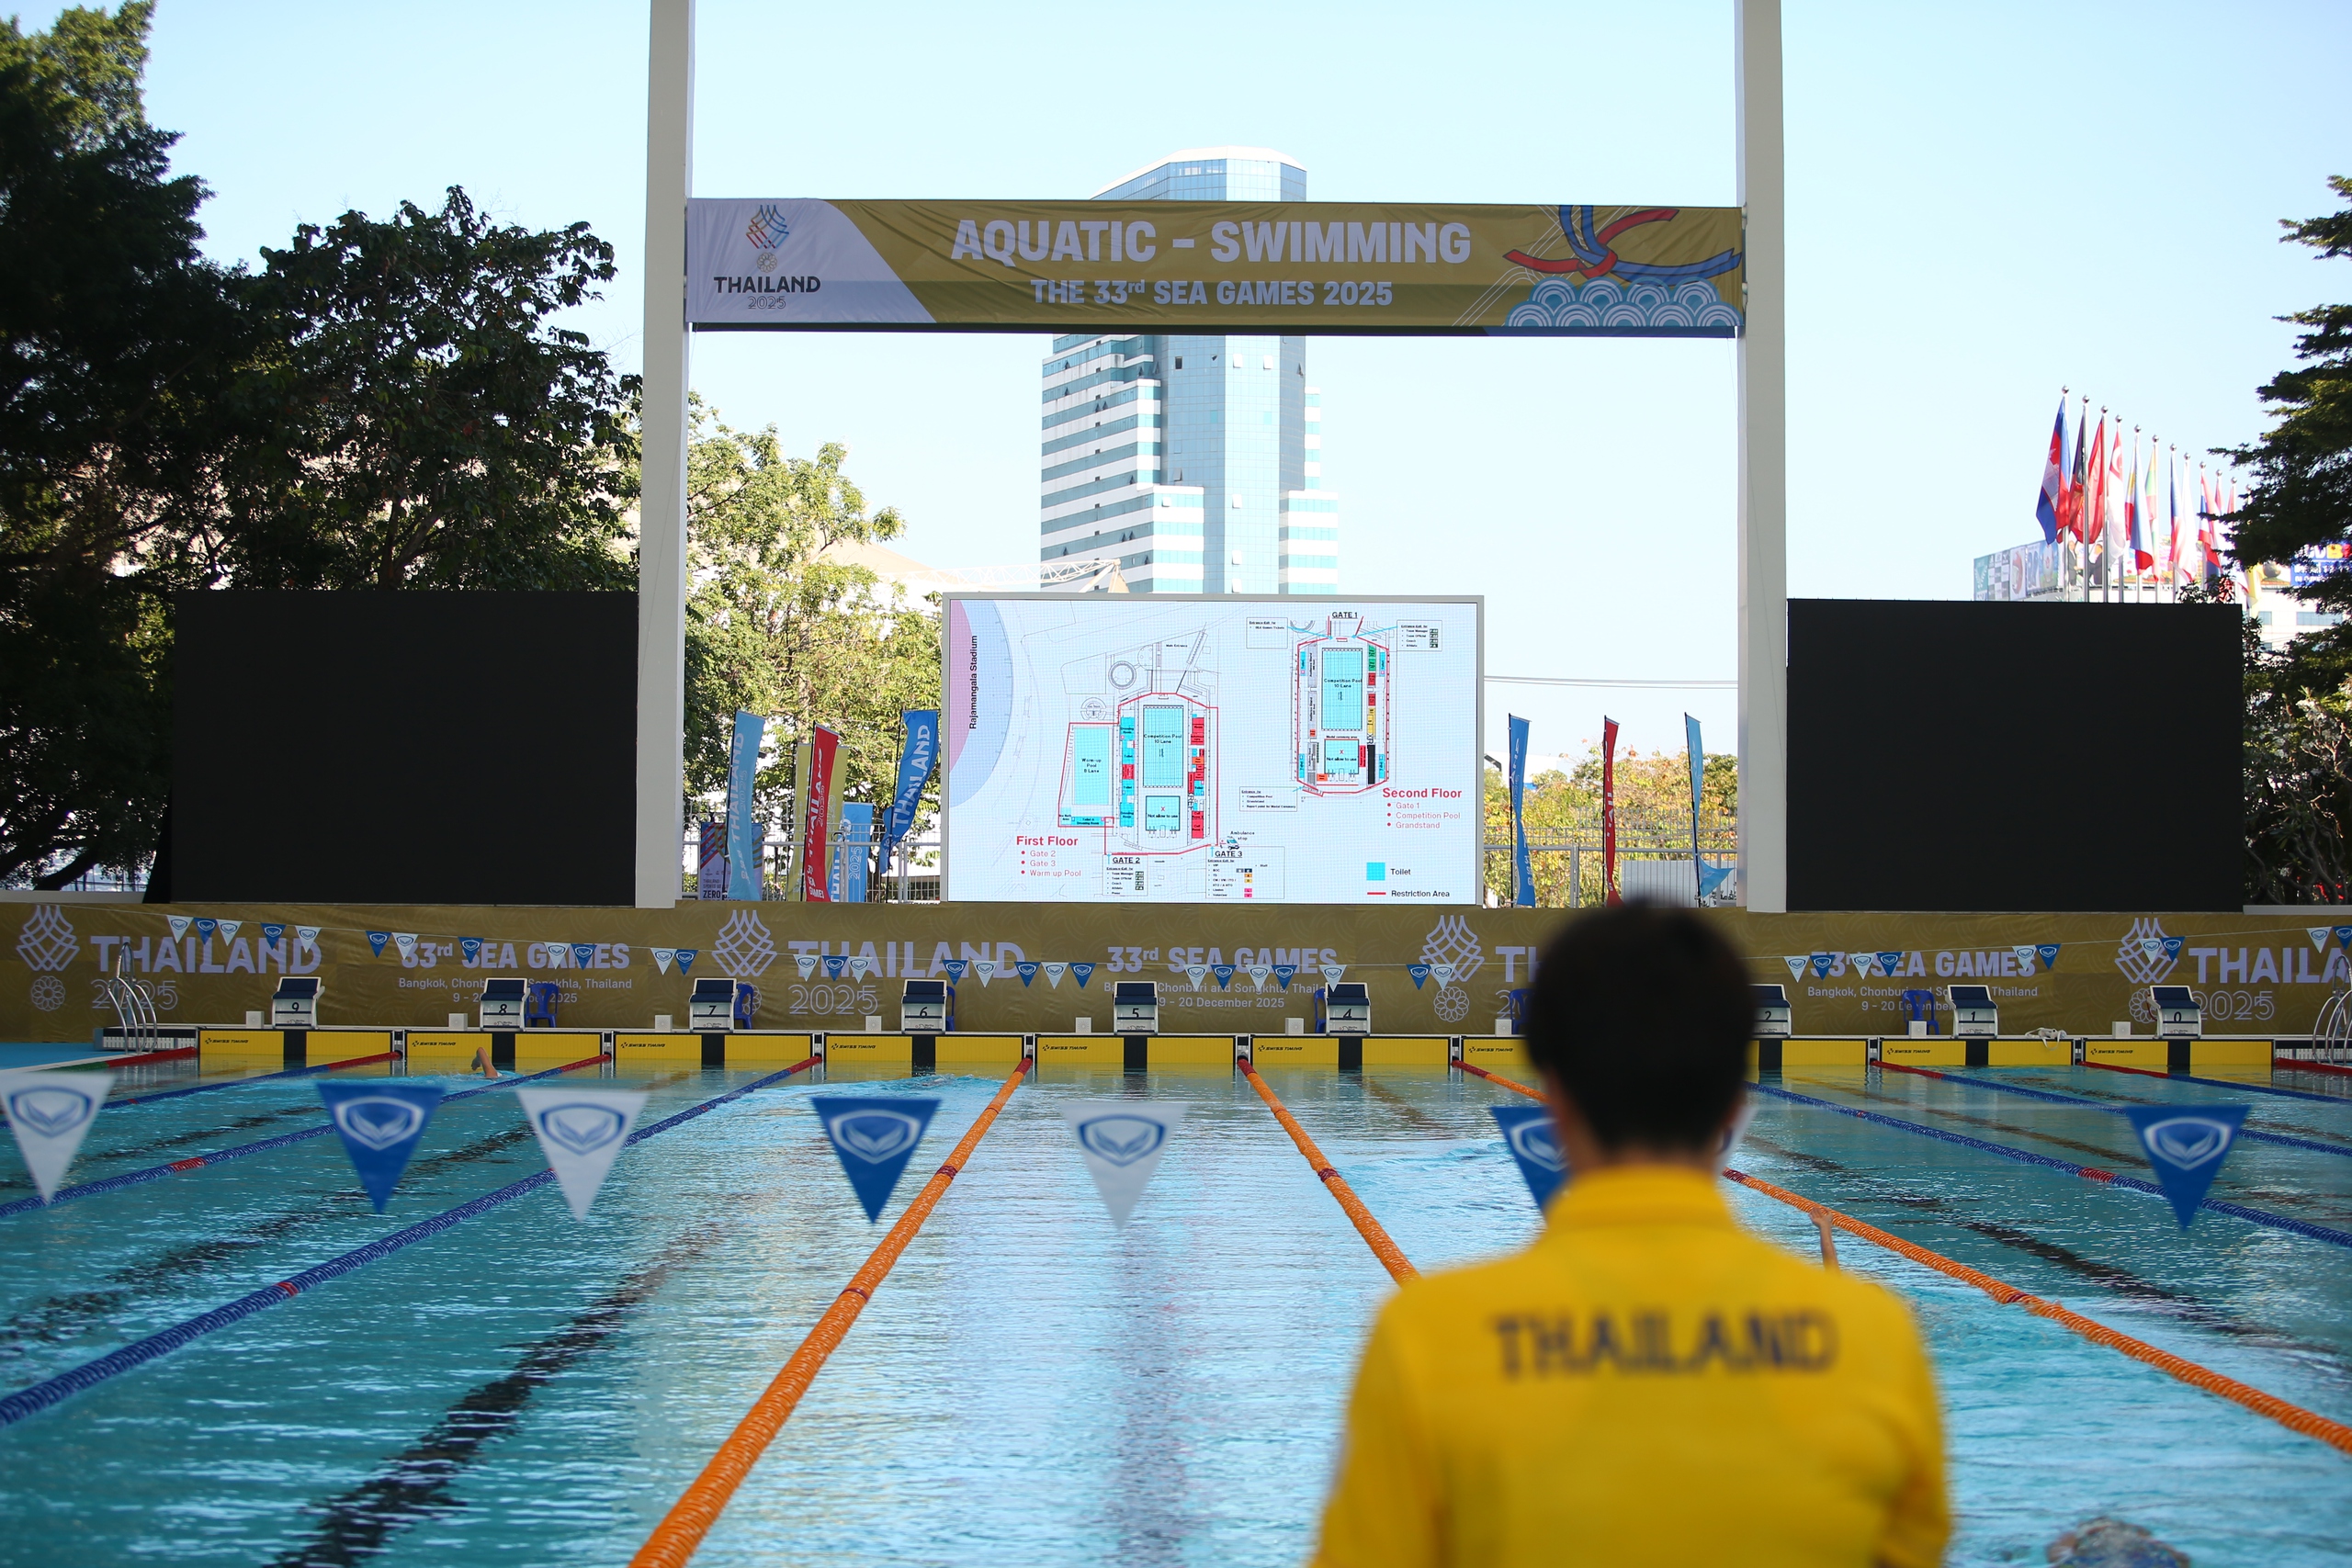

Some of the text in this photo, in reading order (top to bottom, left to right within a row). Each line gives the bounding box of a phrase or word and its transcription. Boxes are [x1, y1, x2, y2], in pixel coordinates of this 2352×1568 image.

[951, 220, 1156, 267] AQUATIC
[1210, 220, 1471, 264] SWIMMING
[713, 276, 821, 294] THAILAND
[1031, 278, 1393, 307] THE 33rd SEA GAMES 2025
[747, 295, 787, 310] 2025
[969, 635, 978, 730] Rajamangala Stadium
[730, 731, 745, 843] THAILAND
[1383, 787, 1463, 798] Second Floor
[1396, 811, 1461, 820] Competition Pool
[1016, 835, 1079, 846] First Floor
[703, 890, 721, 898] ZERO
[90, 935, 322, 975] THAILAND
[788, 941, 1025, 978] THAILAND
[1106, 946, 1338, 975] 33rd SEA GAMES
[399, 978, 448, 990] Bangkok,
[451, 978, 486, 988] Chonb
[584, 978, 632, 989] Thailand
[1292, 983, 1325, 994] Thail
[453, 993, 460, 1002] 9
[1808, 987, 1857, 998] Bangkok,
[1991, 987, 2038, 997] Thailand
[788, 985, 879, 1016] 2025
[1159, 997, 1166, 1007] 9
[1178, 998, 1193, 1008] 20
[1196, 997, 1252, 1008] December
[1256, 998, 1284, 1008] 2025
[1861, 1001, 1869, 1010] 9
[1881, 1001, 1895, 1010] 20
[2191, 990, 2275, 1021] 2025
[291, 1002, 300, 1012] 9
[498, 1003, 507, 1014] 8
[708, 1005, 717, 1016] 7
[920, 1007, 928, 1017] 6
[1132, 1008, 1139, 1018] 5
[1342, 1008, 1352, 1019] 4
[1764, 1010, 1771, 1021] 2
[1971, 1011, 1976, 1021] 1
[2174, 1011, 2182, 1022] 0
[1487, 1309, 1838, 1379] THAILAND
